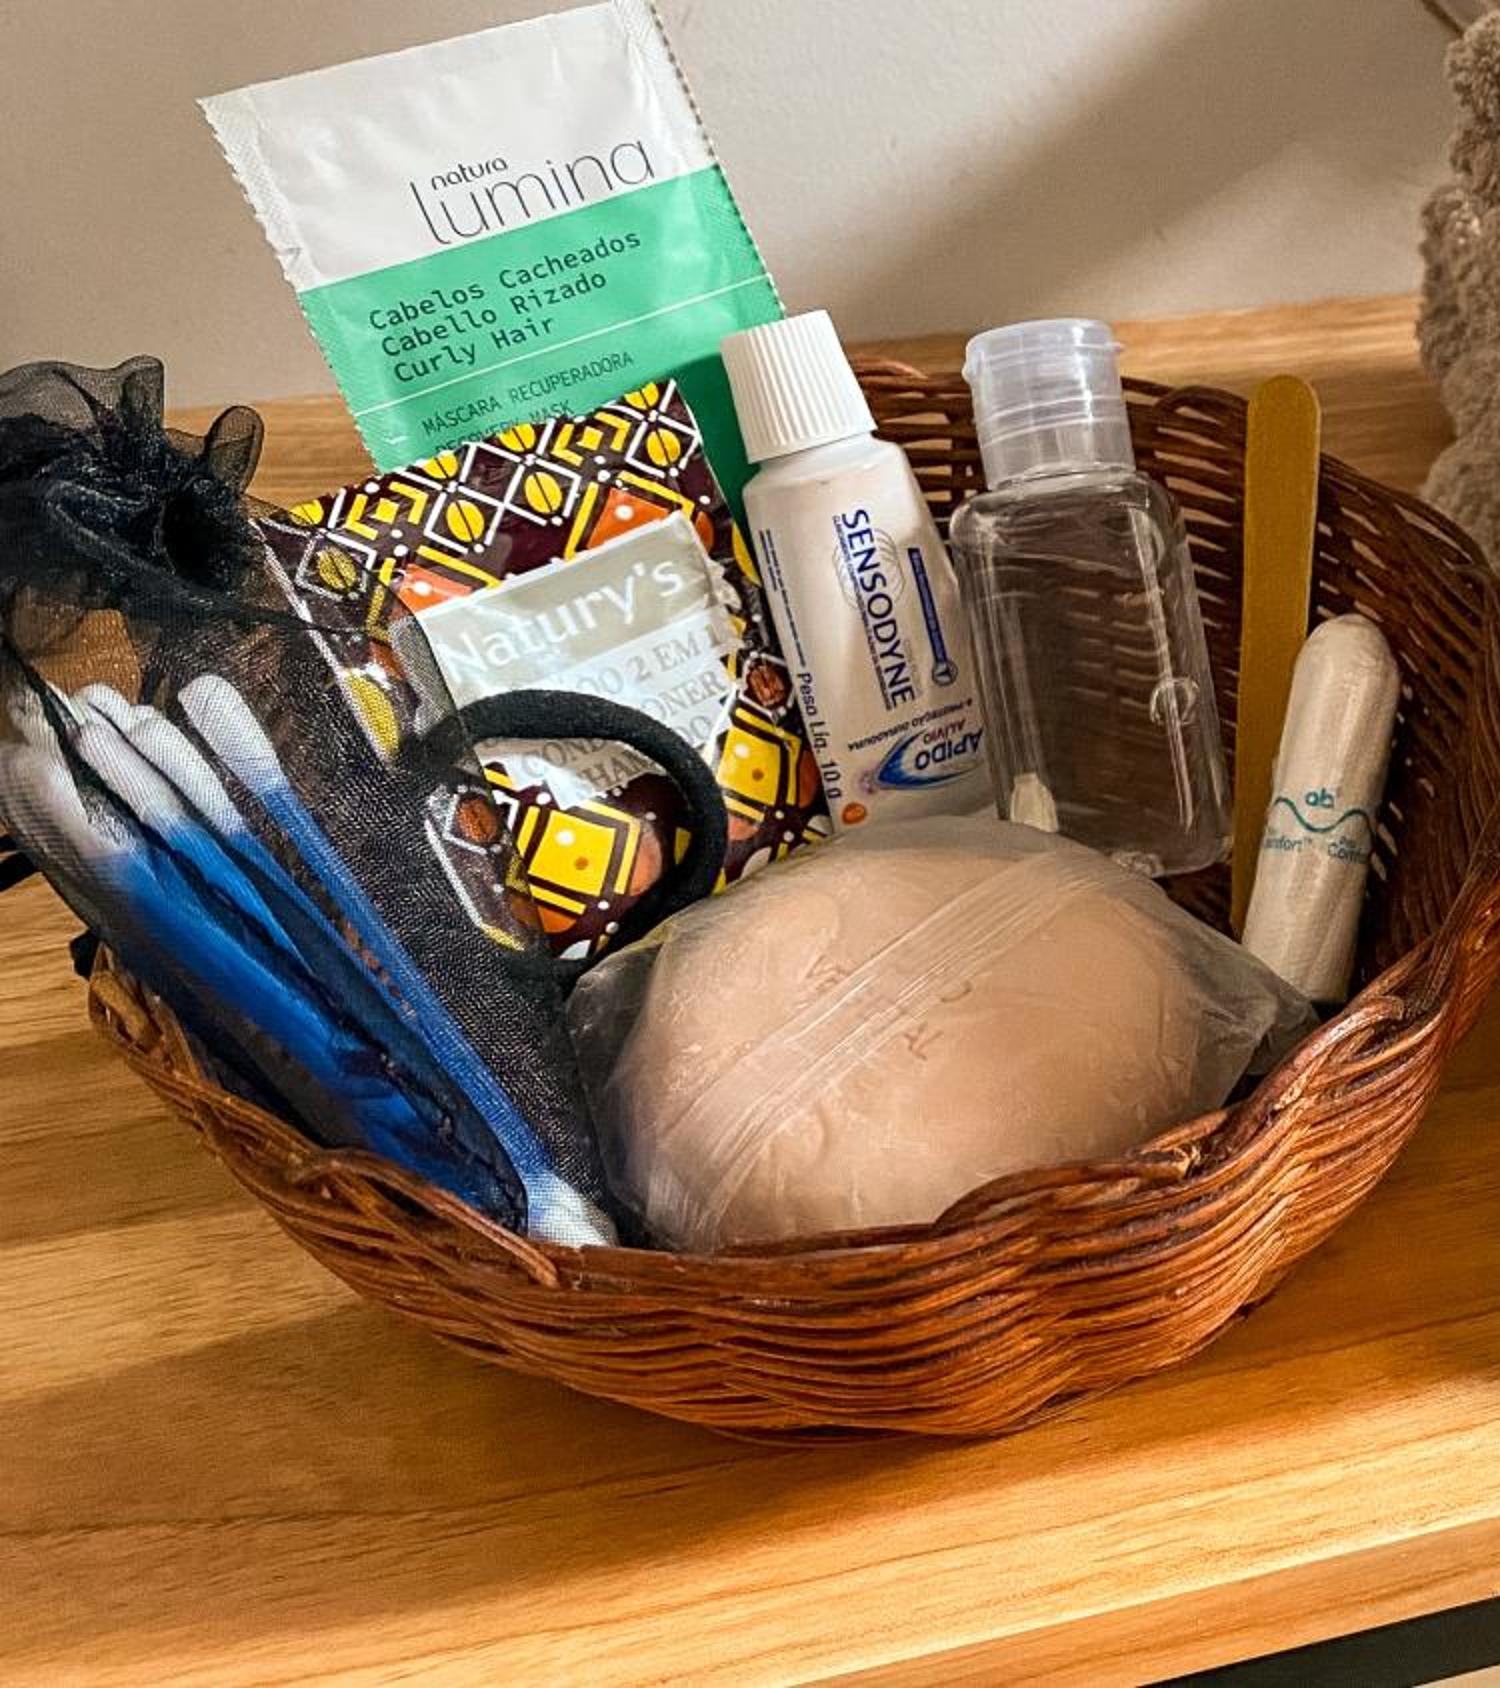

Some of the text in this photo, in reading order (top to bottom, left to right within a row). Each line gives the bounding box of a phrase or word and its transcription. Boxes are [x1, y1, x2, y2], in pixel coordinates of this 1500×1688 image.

[409, 139, 655, 246] lumina
[430, 156, 509, 191] natura
[368, 231, 642, 331] Cabelos Cacheados
[380, 270, 608, 358] Cabello Rizado
[392, 315, 555, 383] Curly Hair
[420, 350, 634, 436] MÁSCARA RECUPERADORA
[435, 560, 686, 682] Natury's
[841, 507, 916, 707] SENSODYNE
[628, 655, 653, 682] 2
[653, 631, 705, 673] EM
[797, 672, 818, 716] Peso
[820, 759, 842, 782] 10
[914, 728, 983, 771] APIDO
